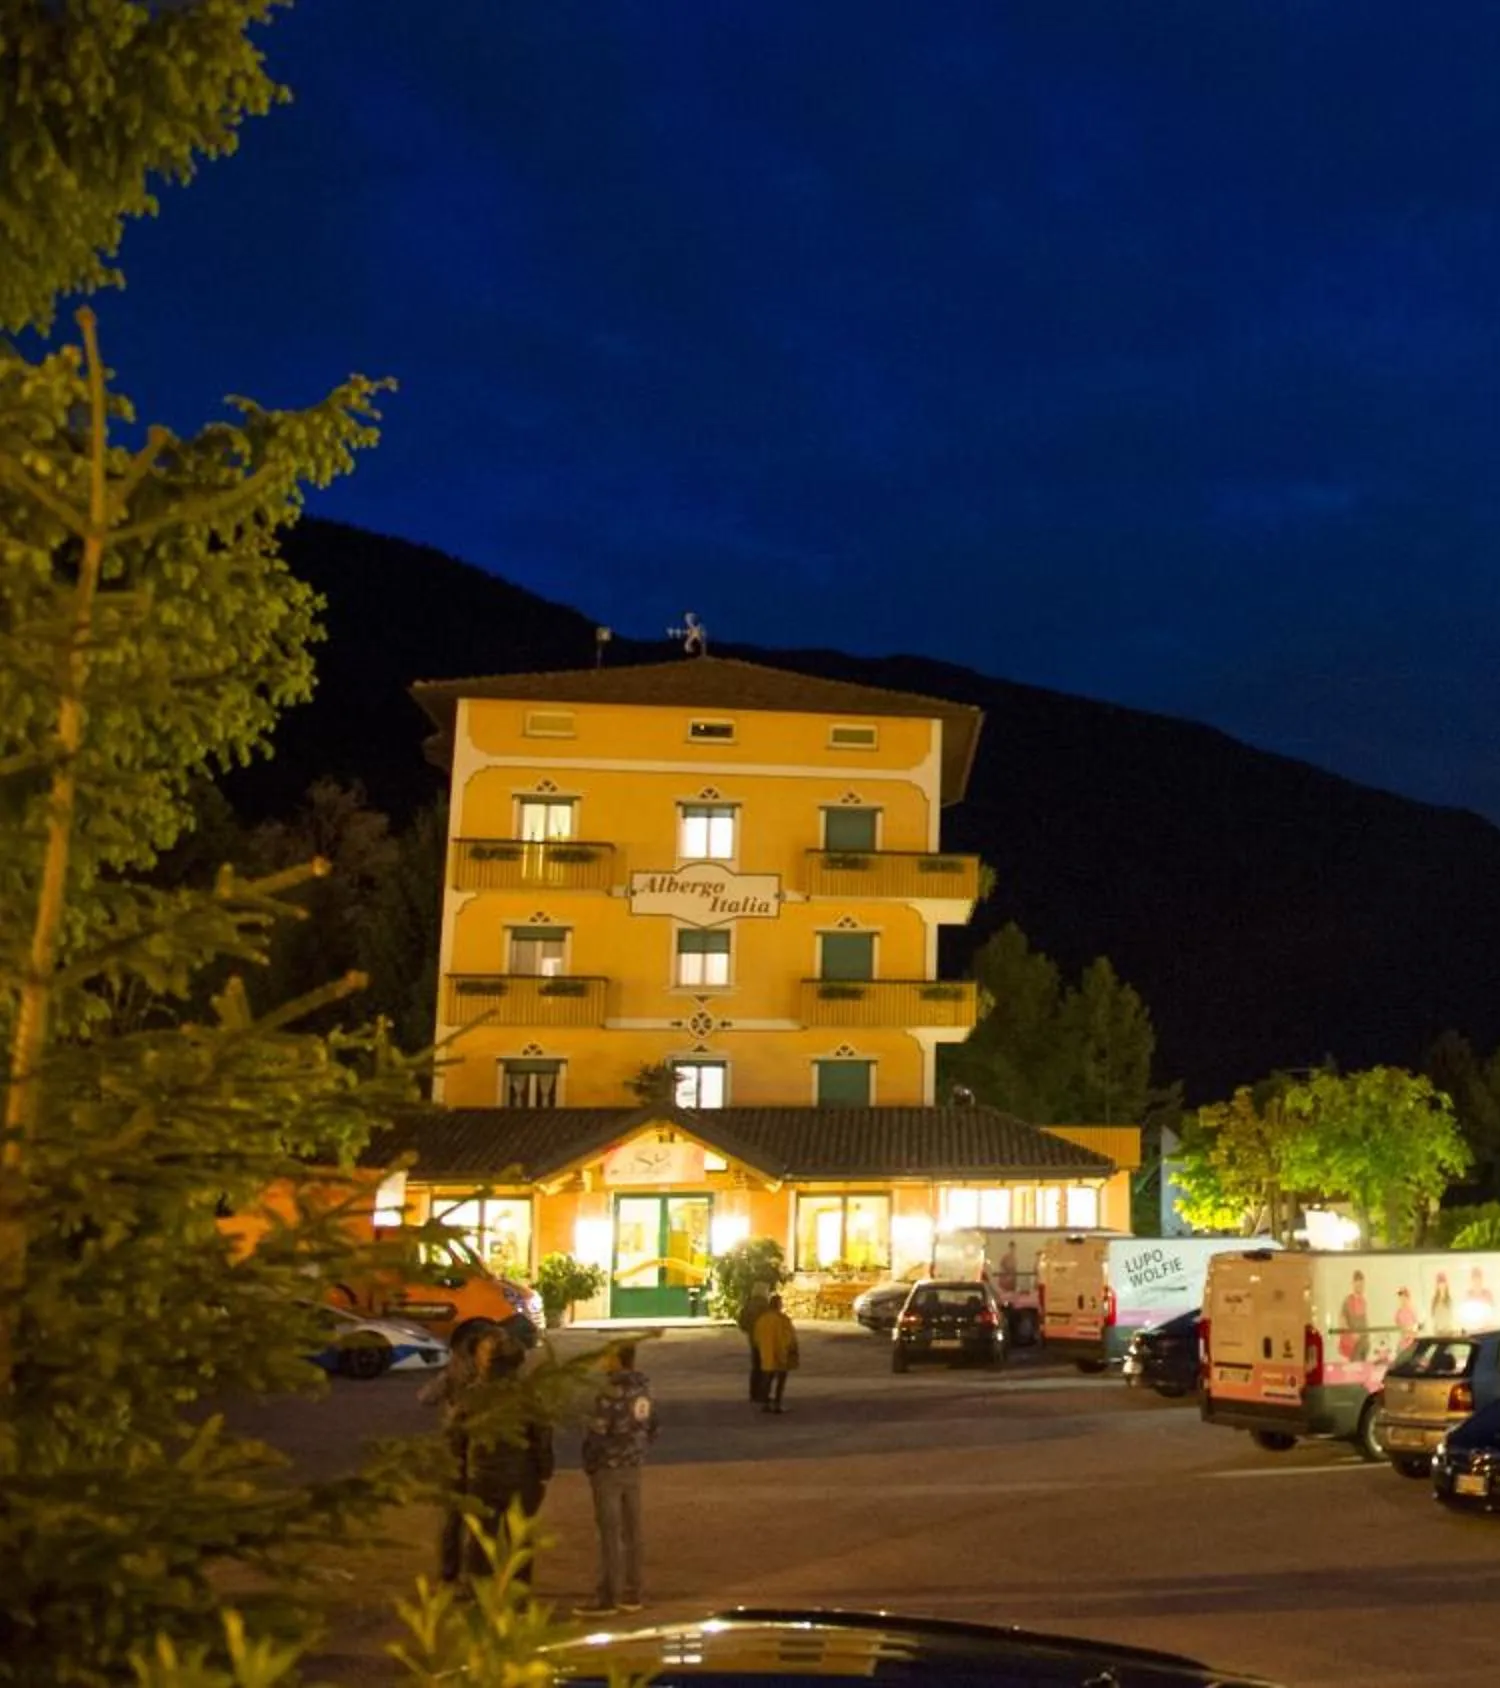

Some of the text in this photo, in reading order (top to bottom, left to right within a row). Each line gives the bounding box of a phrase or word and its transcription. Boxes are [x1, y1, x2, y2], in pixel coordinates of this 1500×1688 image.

[642, 876, 725, 898] Albergo
[709, 896, 771, 913] Italia
[1124, 1249, 1164, 1273] LUPO
[1129, 1257, 1184, 1288] WOLFIE
